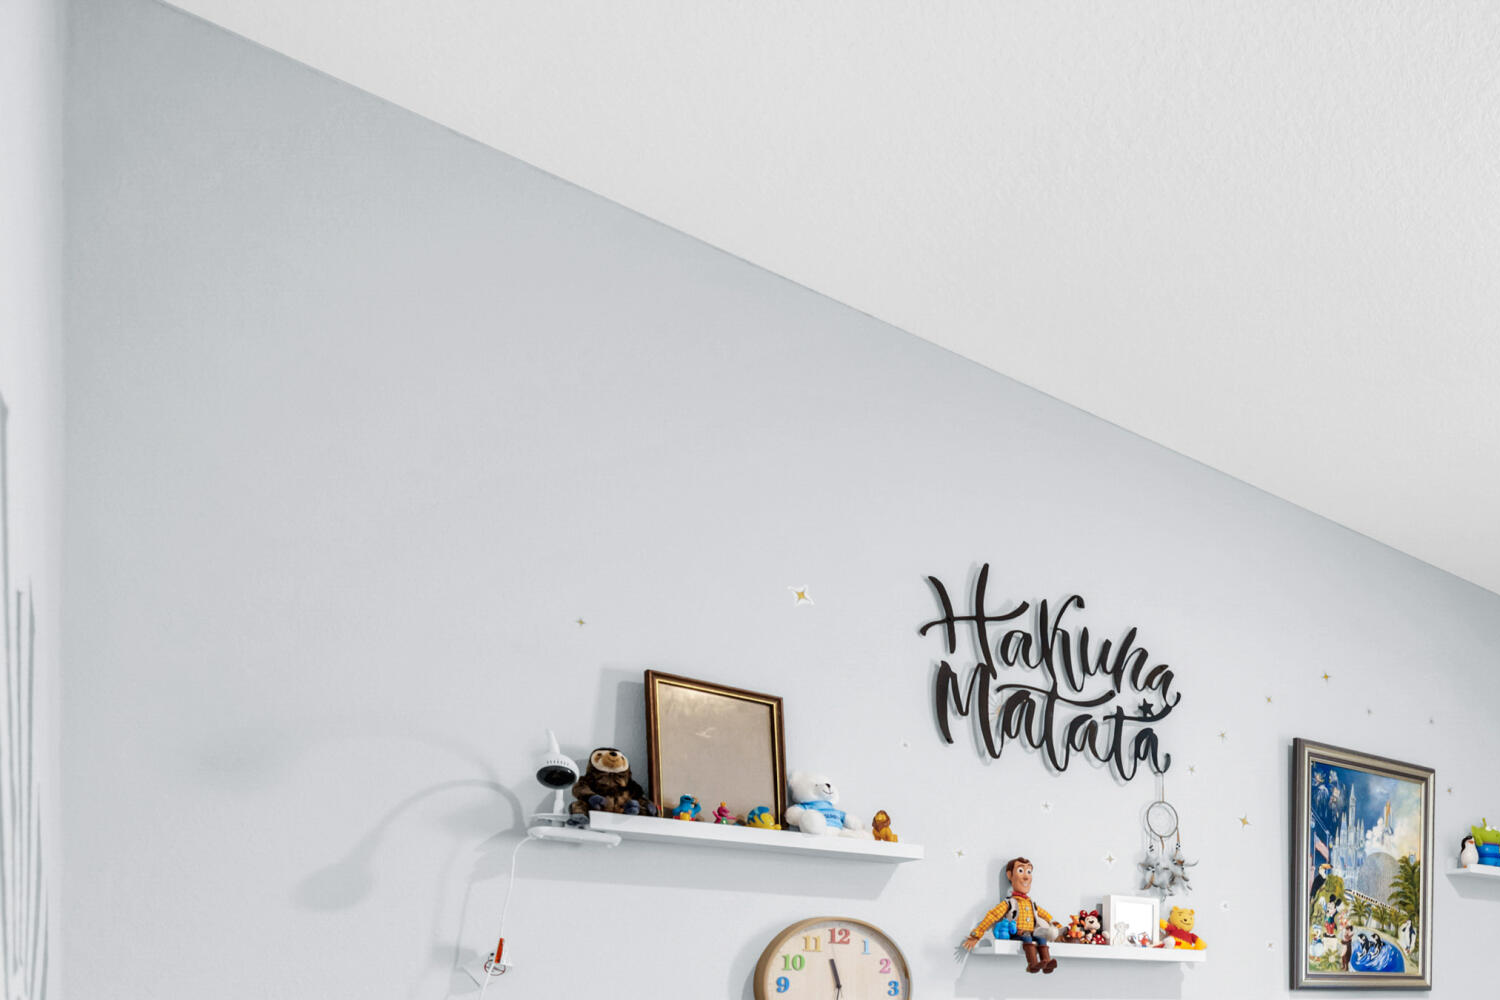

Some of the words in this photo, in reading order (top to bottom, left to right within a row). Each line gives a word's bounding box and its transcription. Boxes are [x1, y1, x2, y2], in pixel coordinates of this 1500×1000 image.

[920, 563, 1181, 708] Hakuna
[936, 660, 1175, 780] Matata
[803, 935, 822, 952] 11
[828, 927, 850, 944] 12
[861, 938, 871, 955] 1
[782, 954, 805, 971] 10
[880, 958, 891, 974] 2
[776, 976, 790, 993] 9
[888, 980, 899, 996] 3
